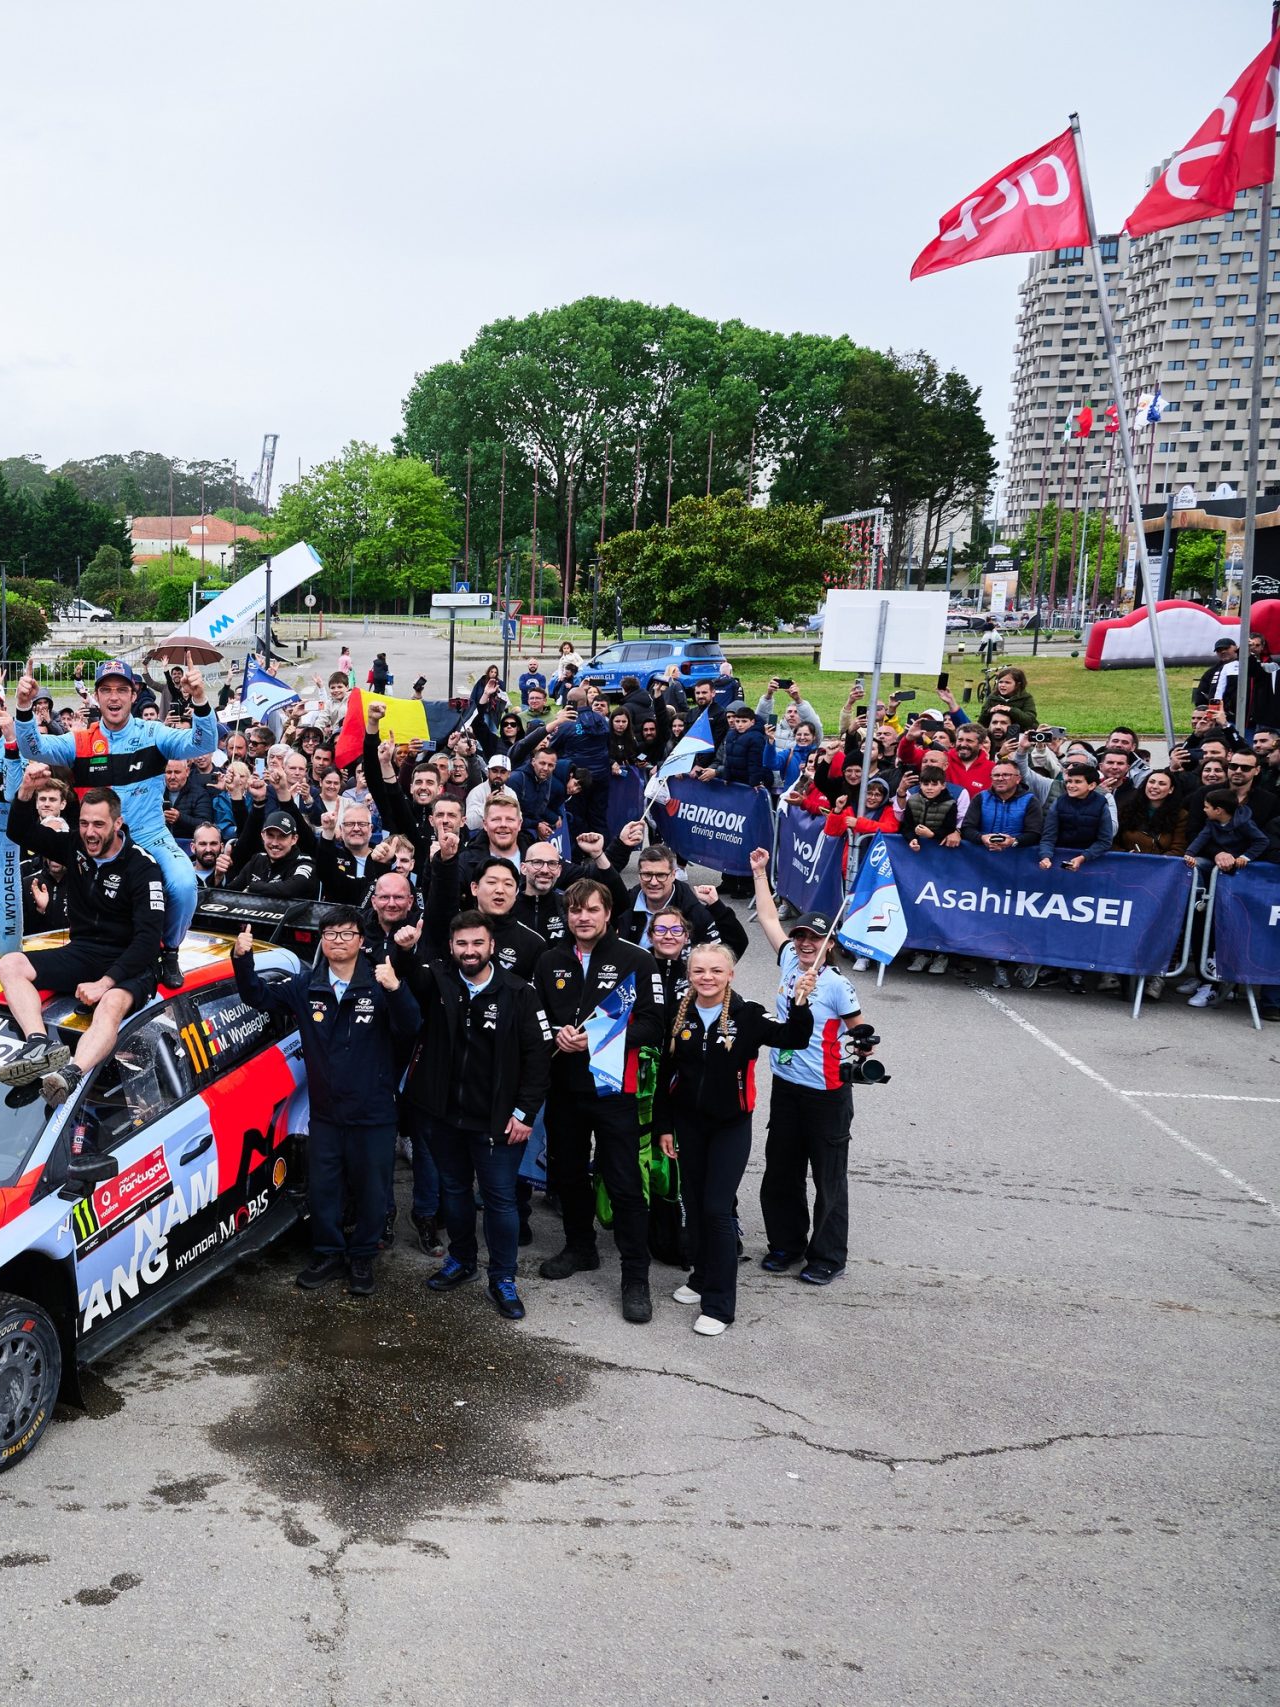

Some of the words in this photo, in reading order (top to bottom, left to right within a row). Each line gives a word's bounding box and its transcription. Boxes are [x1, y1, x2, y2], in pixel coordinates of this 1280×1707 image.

[691, 823, 715, 840] driving
[715, 829, 743, 845] emotion
[4, 851, 16, 919] WYDAEGHE
[230, 906, 285, 920] HYUND
[210, 1015, 221, 1031] T.
[221, 1001, 253, 1025] Neuvi
[218, 1036, 230, 1053] M.
[229, 1010, 271, 1044] Wydaeghe
[180, 1022, 209, 1074] 11
[119, 1158, 165, 1197] Portugal
[73, 1198, 95, 1240] 11
[100, 1202, 119, 1218] vodafone
[85, 1238, 99, 1251] WRC
[175, 1233, 217, 1271] HYUNDAI
[219, 1189, 269, 1244] MOBIS
